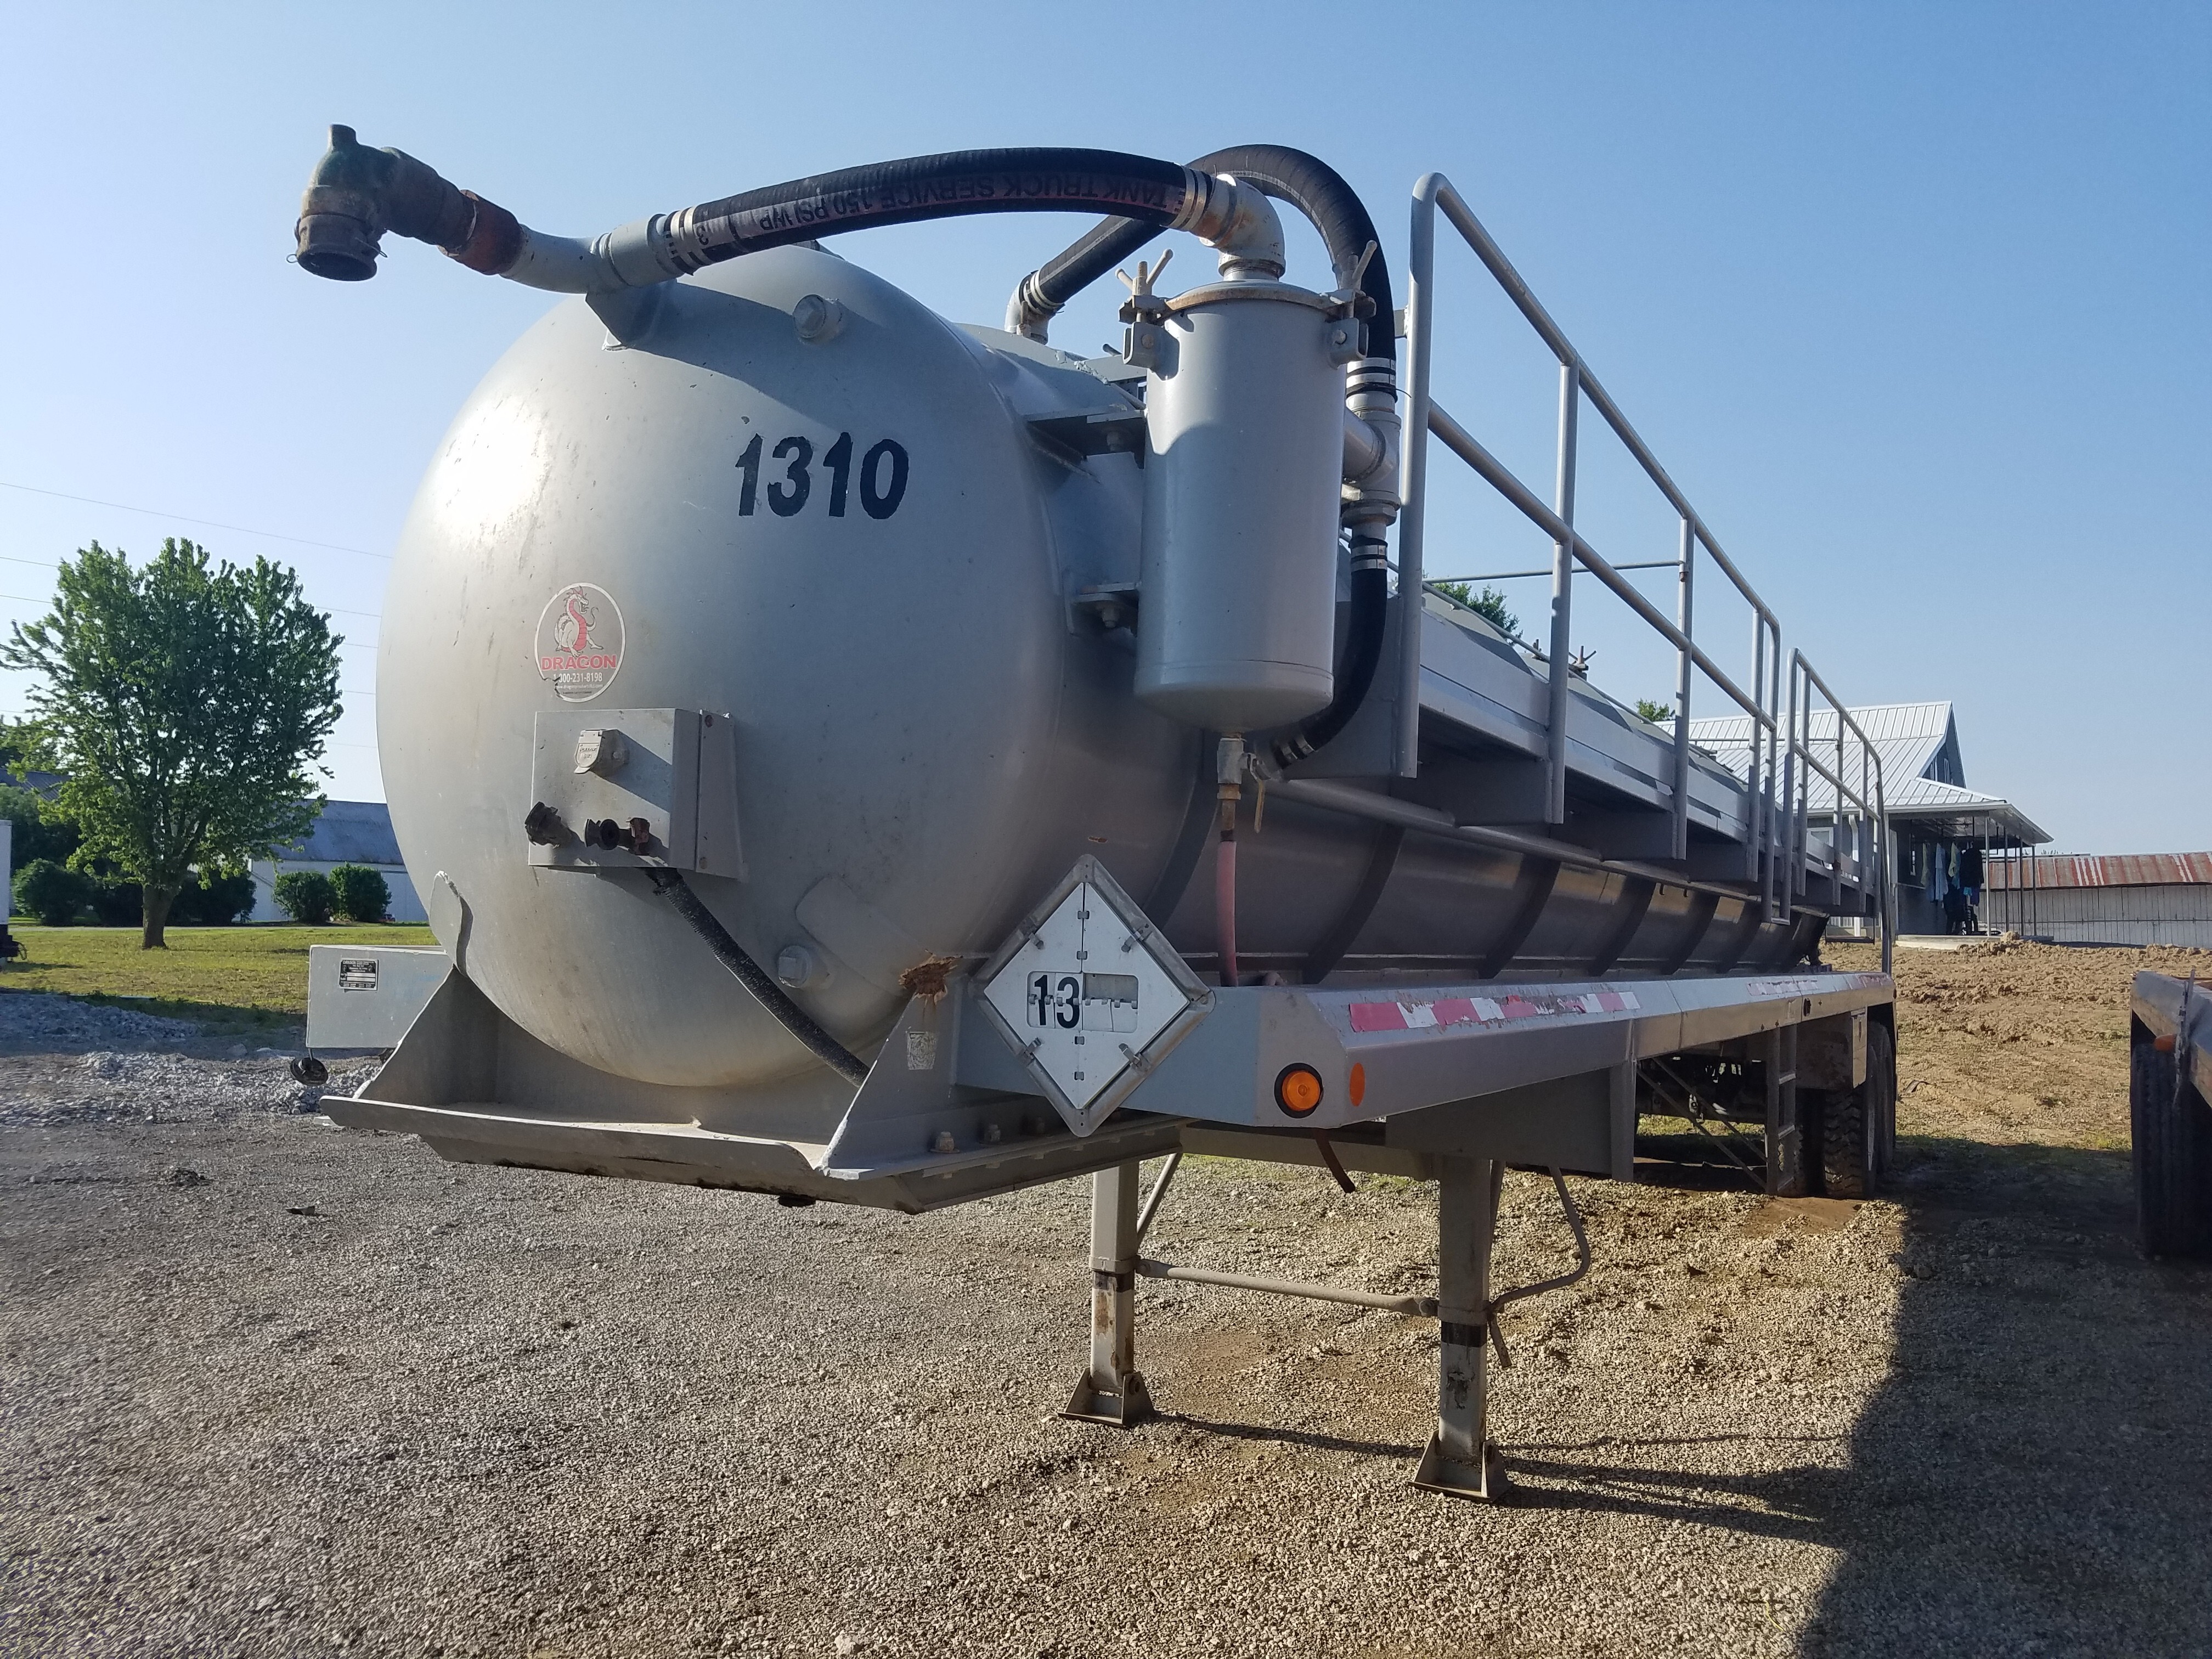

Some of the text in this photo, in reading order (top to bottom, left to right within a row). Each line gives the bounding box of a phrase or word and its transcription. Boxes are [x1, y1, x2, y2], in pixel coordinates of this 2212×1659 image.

[881, 177, 994, 209] SERVICE
[1003, 174, 1098, 198] TRUCK
[1103, 178, 1167, 208] TANK
[793, 198, 829, 224] PSI
[833, 189, 873, 215] 150
[735, 432, 909, 519] 1310
[541, 654, 617, 671] DRAGON
[554, 672, 602, 683] 1800-231-8198
[1034, 974, 1080, 1029] 13
